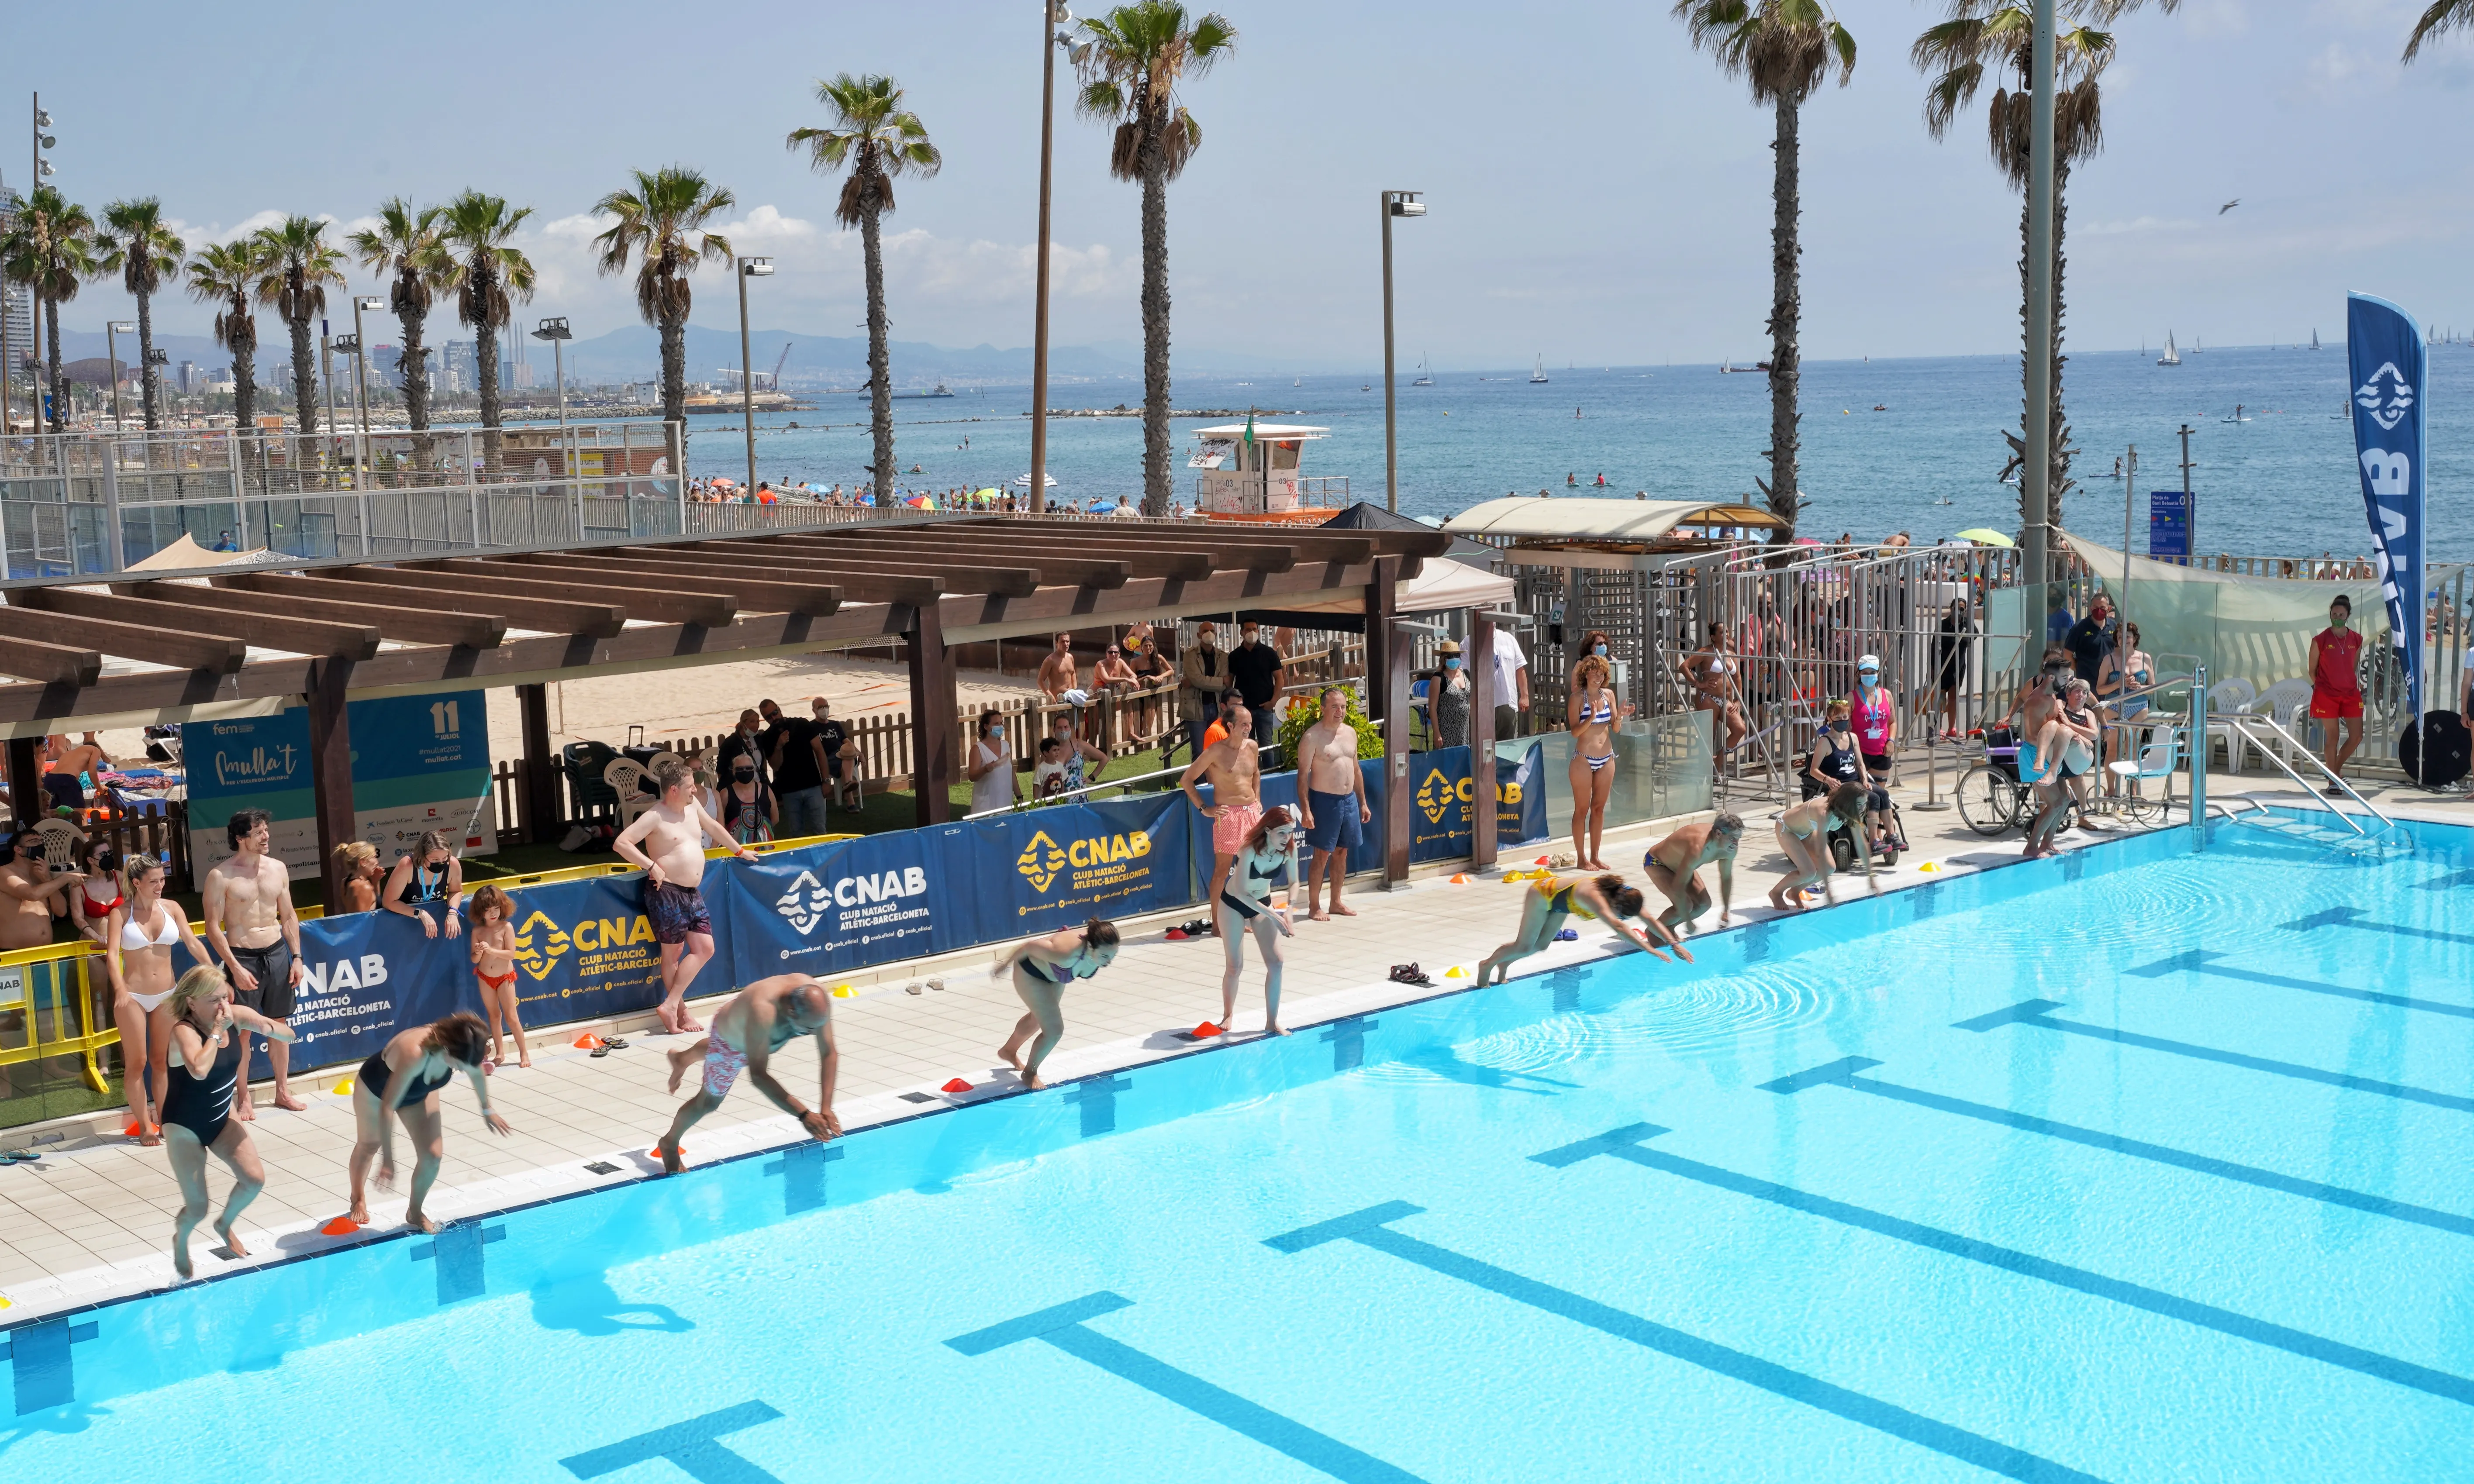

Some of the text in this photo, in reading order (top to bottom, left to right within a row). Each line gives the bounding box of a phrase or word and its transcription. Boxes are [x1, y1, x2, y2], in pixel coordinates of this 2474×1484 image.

[430, 700, 459, 733] 11
[213, 723, 238, 735] fem
[419, 745, 461, 755] #mullat2021
[425, 754, 462, 763] mullat.cat
[1069, 831, 1151, 868] CNAB
[286, 861, 320, 869] tropolitana
[1073, 863, 1126, 881] CLUB NATACIÓ
[834, 867, 927, 907] CNAB
[1073, 867, 1150, 890] ATLÈTIC-BARCELONETA
[1027, 883, 1152, 912] www.cnab.cat cnab_oficial cnab.oficial cnab_oficial
[840, 901, 897, 920] CLUB NATACIÓ
[840, 908, 929, 931] ATLÈTIC-BARCELONETA
[573, 914, 656, 951] CNA
[790, 925, 932, 955] www.cnab.cat cnab_oficial cnab.oficial cnab_oficial
[579, 947, 646, 966] CLUB NATACIÓ
[580, 956, 662, 977] ATLÈTIC-BARCELO
[295, 954, 388, 997] NAB
[521, 978, 643, 1002] www.cnab.cat cnab_oficial cnab.oficial
[285, 1000, 391, 1027] TLÈTIC-BARCELONETA
[305, 994, 351, 1012] NATACIÓ
[288, 1019, 394, 1045] oficial cnab.oficial cnab_oficial
